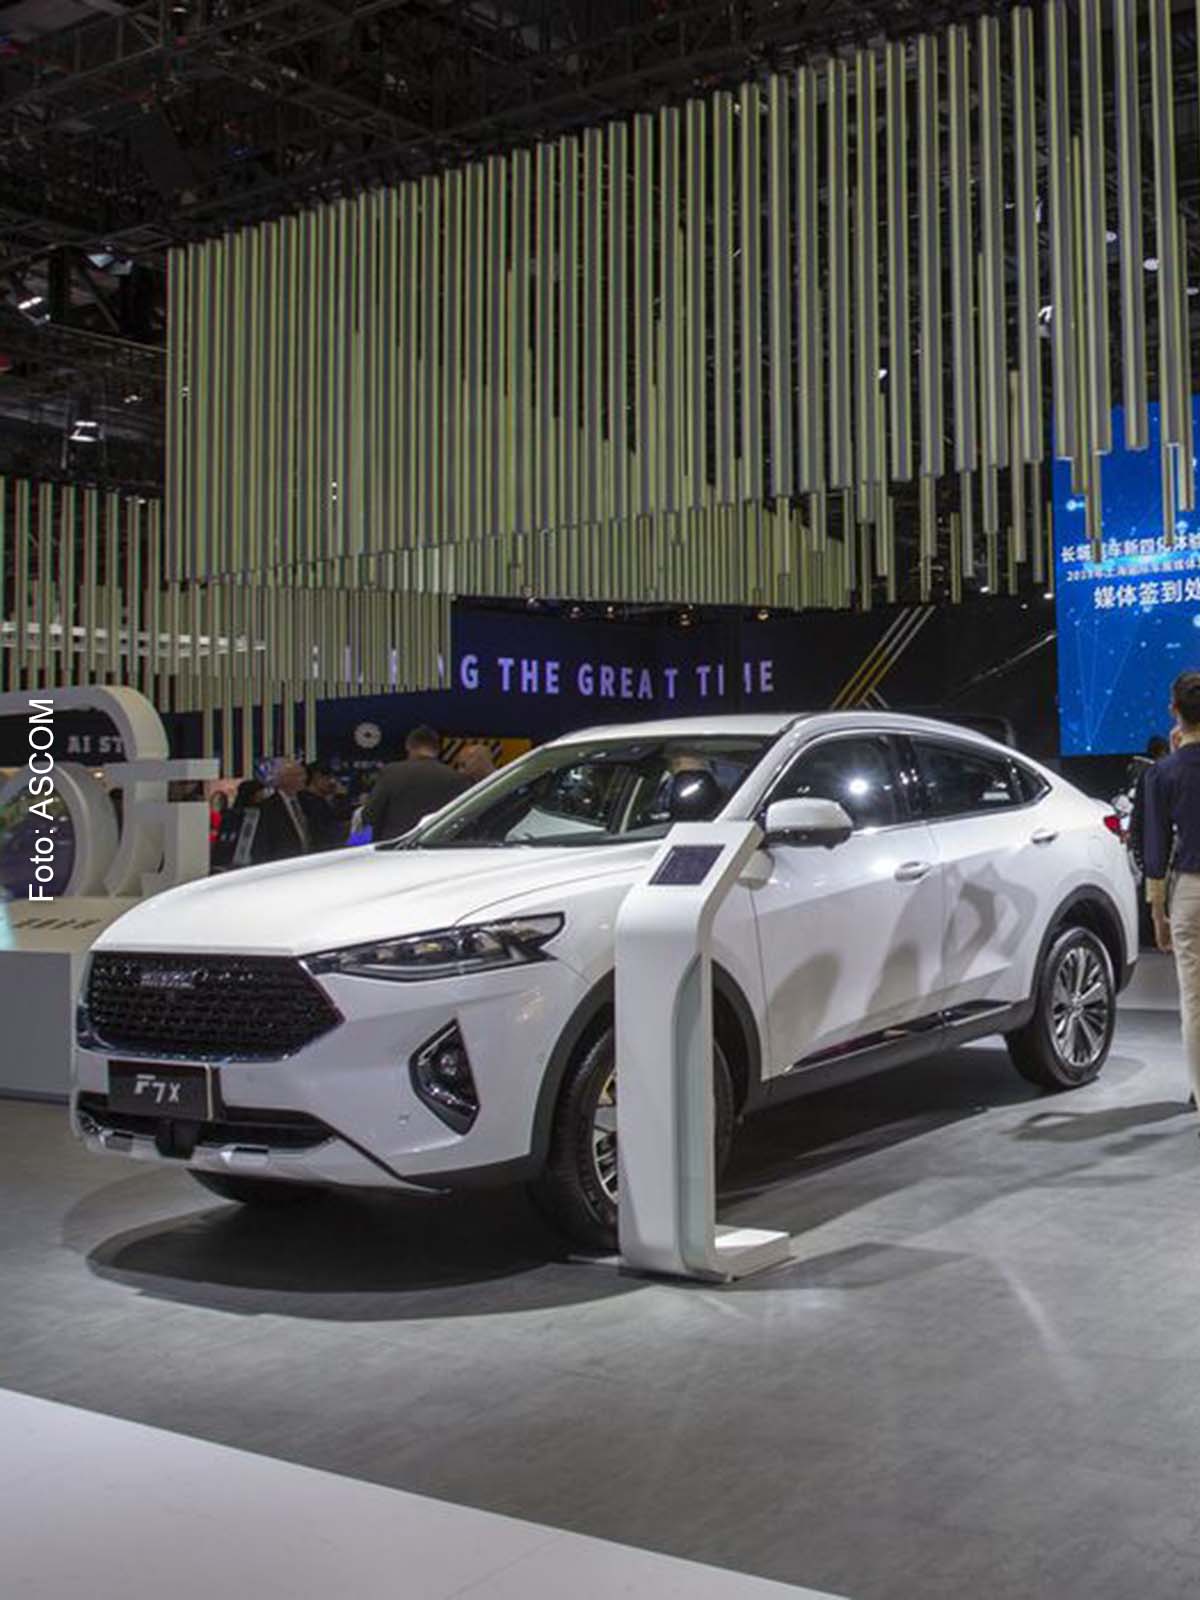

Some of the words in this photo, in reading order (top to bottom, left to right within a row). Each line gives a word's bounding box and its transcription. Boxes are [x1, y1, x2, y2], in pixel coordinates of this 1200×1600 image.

[497, 657, 560, 695] THE
[577, 663, 679, 699] GREAT
[67, 735, 91, 753] AI
